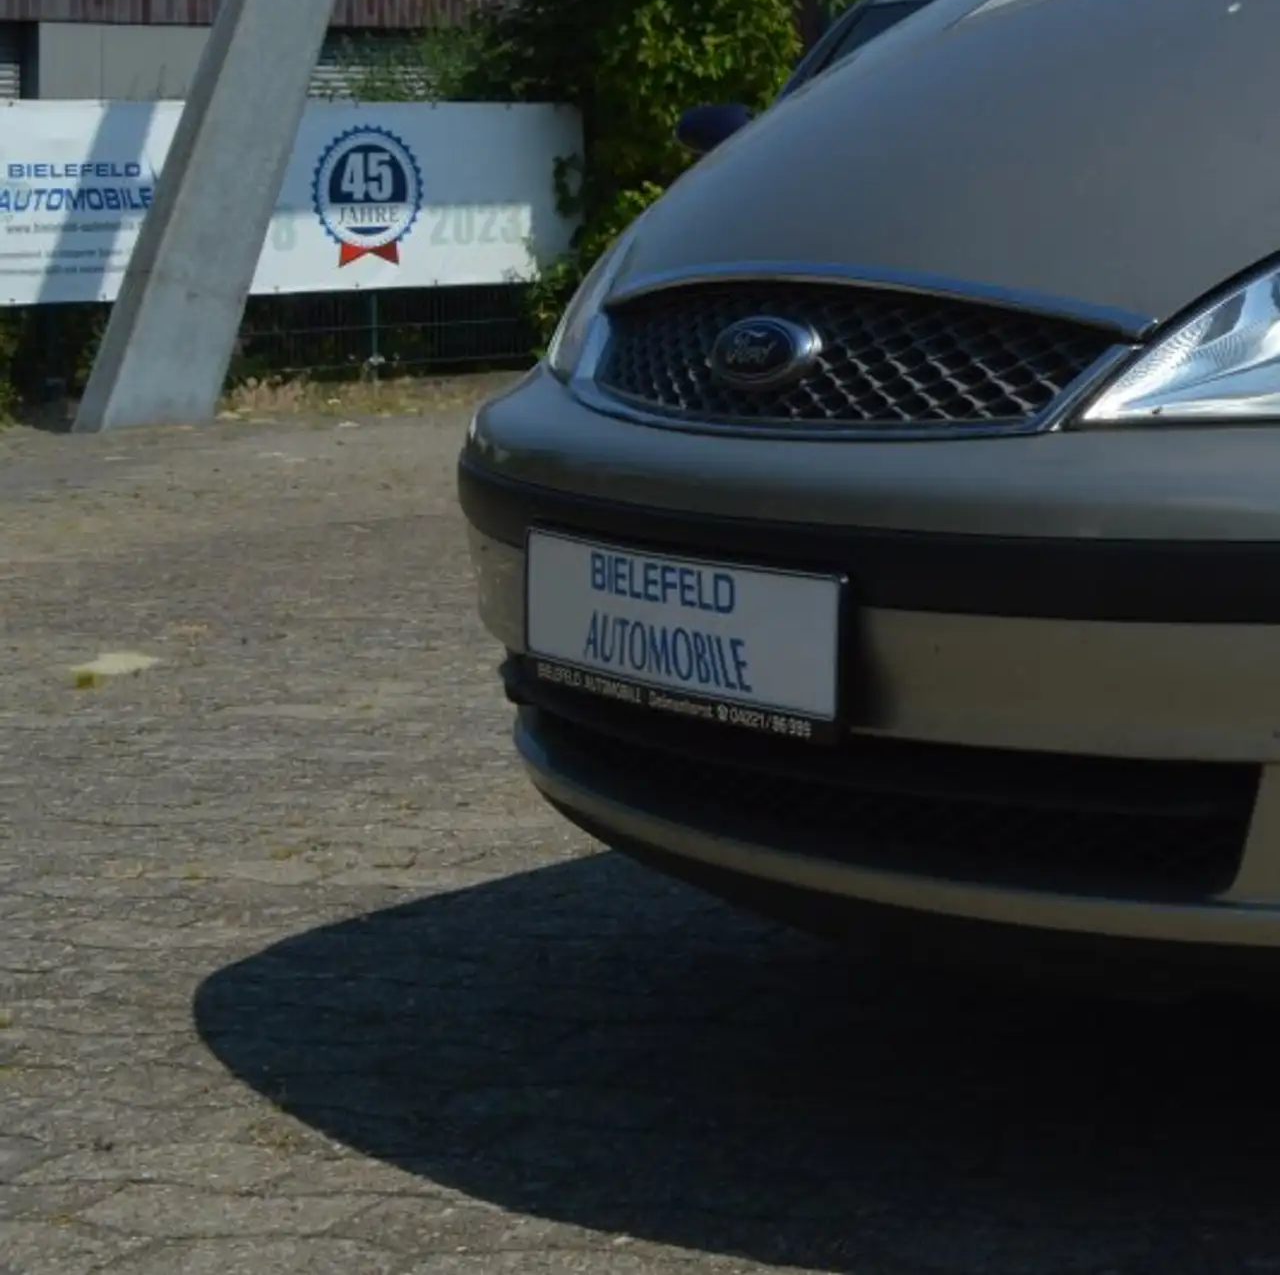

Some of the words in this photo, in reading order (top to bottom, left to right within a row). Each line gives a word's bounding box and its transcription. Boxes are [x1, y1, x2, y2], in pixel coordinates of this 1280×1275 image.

[7, 163, 141, 178] BIELEFELD
[340, 152, 394, 201] 45
[338, 204, 400, 224] JAHRE
[429, 202, 523, 246] 2023
[590, 552, 735, 614] BIELEFELD
[583, 609, 752, 693] AUTOMOBILE
